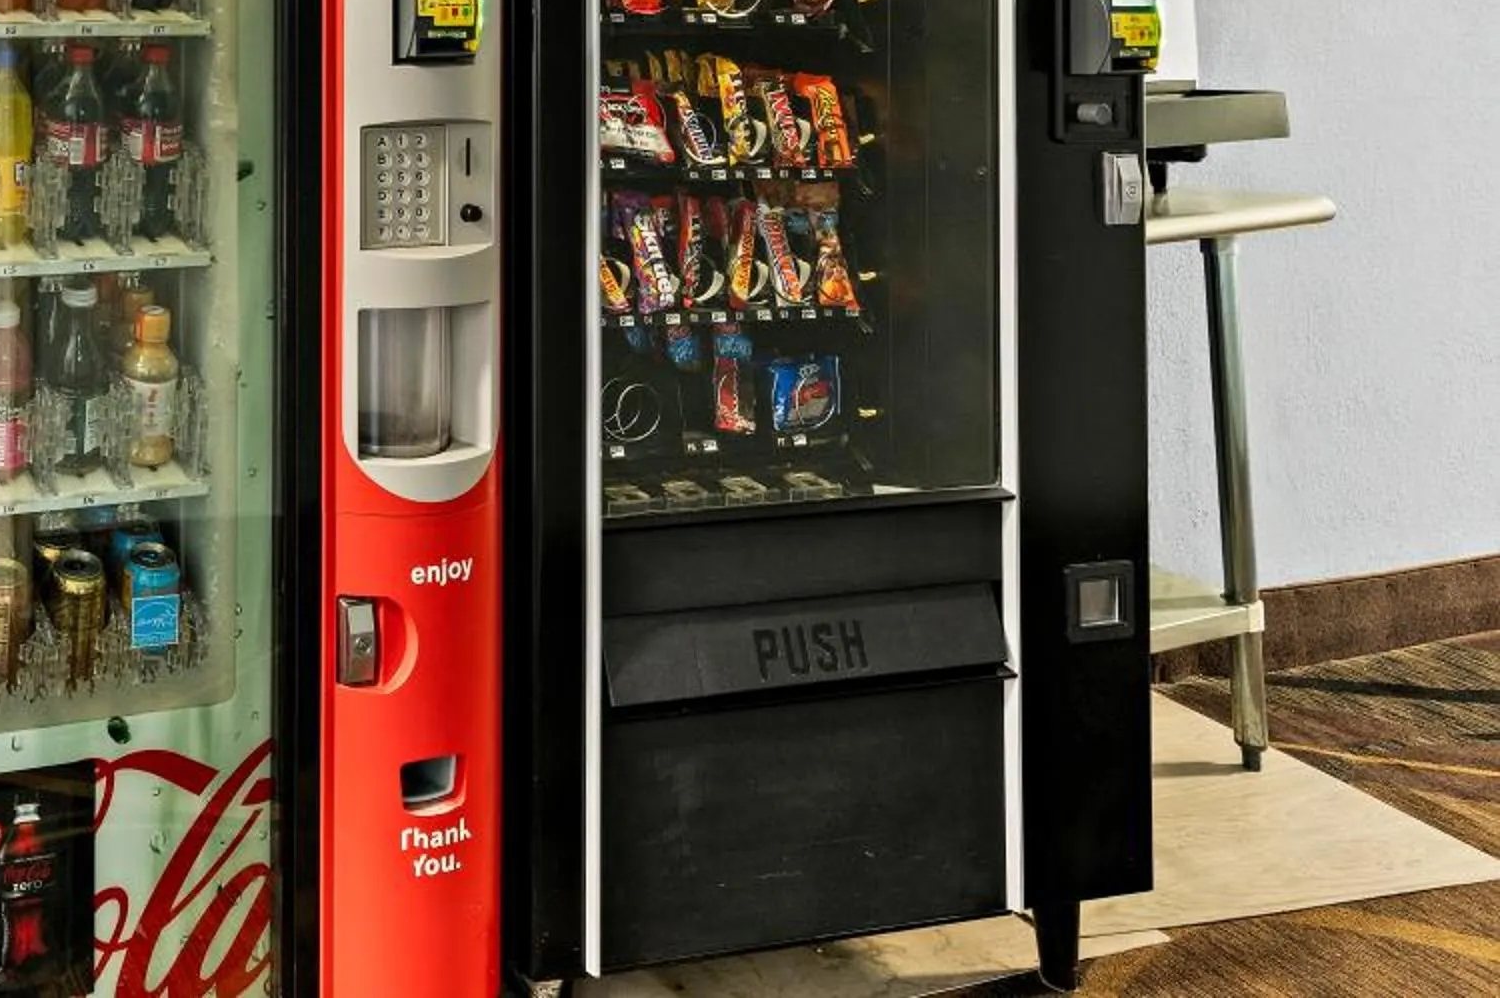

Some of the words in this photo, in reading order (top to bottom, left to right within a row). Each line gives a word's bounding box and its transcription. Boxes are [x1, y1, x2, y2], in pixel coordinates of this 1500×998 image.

[411, 557, 473, 586] enjoy
[752, 619, 869, 682] PUSH
[400, 817, 472, 851] Thank
[12, 878, 43, 891] zero
